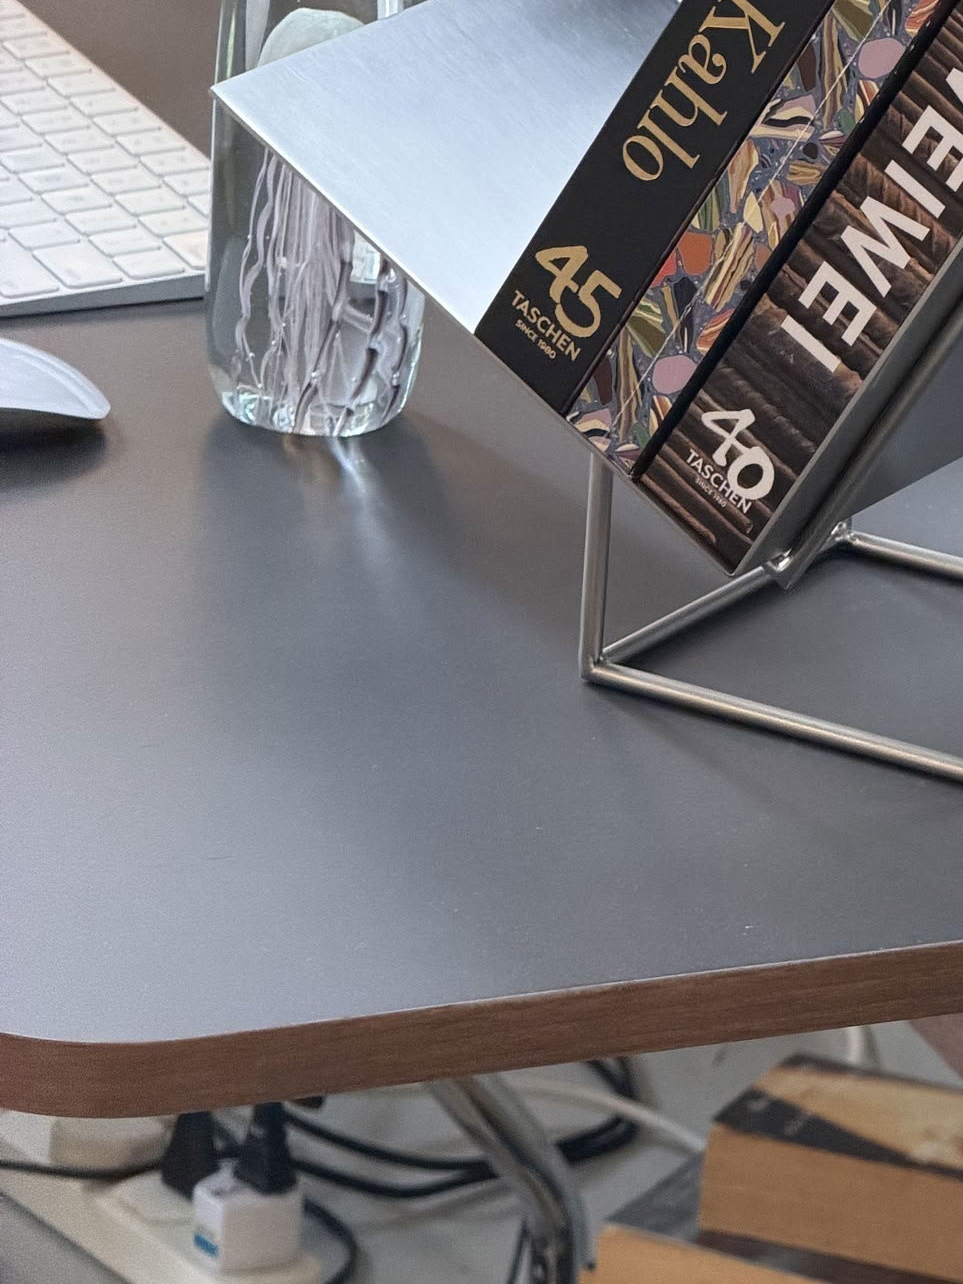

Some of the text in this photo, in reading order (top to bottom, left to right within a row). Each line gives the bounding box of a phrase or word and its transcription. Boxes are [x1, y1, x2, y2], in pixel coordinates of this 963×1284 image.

[511, 289, 582, 362] TASCHEN
[535, 244, 622, 338] 45
[515, 319, 557, 360] SINCE 1980
[685, 449, 752, 514] TASCHEN
[701, 408, 775, 501] 40
